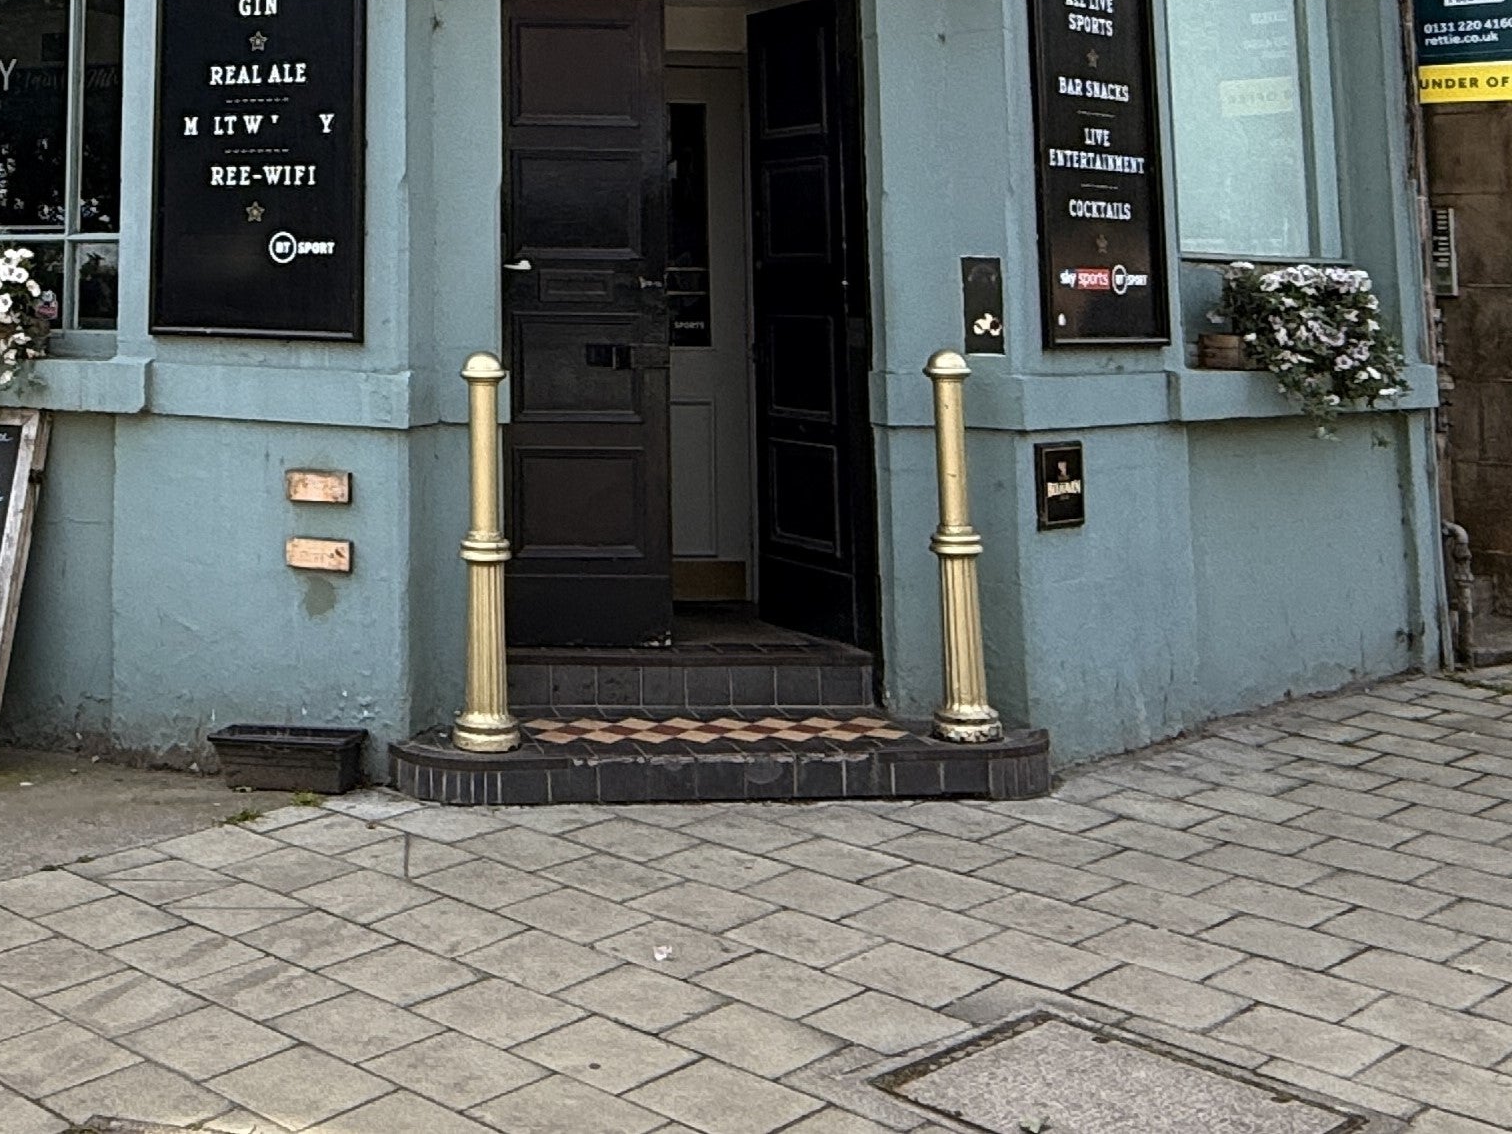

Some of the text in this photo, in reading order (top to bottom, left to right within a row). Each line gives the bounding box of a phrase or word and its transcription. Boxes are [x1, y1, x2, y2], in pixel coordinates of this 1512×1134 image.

[1068, 12, 1113, 37] SPORTS
[1424, 22, 1456, 35] 0131
[1458, 20, 1483, 32] 220
[1425, 31, 1500, 46] rettie.co.uk
[209, 63, 307, 85] REAL ALE
[1419, 76, 1510, 90] UNDER OF
[1058, 76, 1129, 102] BAR SNACKS
[184, 115, 238, 136] MLT
[1084, 128, 1111, 147] LIVE
[1049, 148, 1145, 174] ENTERTAINMENT
[1069, 199, 1131, 220] COCKTAILS
[296, 241, 336, 255] SPORT
[1059, 269, 1076, 288] sky
[1077, 273, 1109, 288] sports
